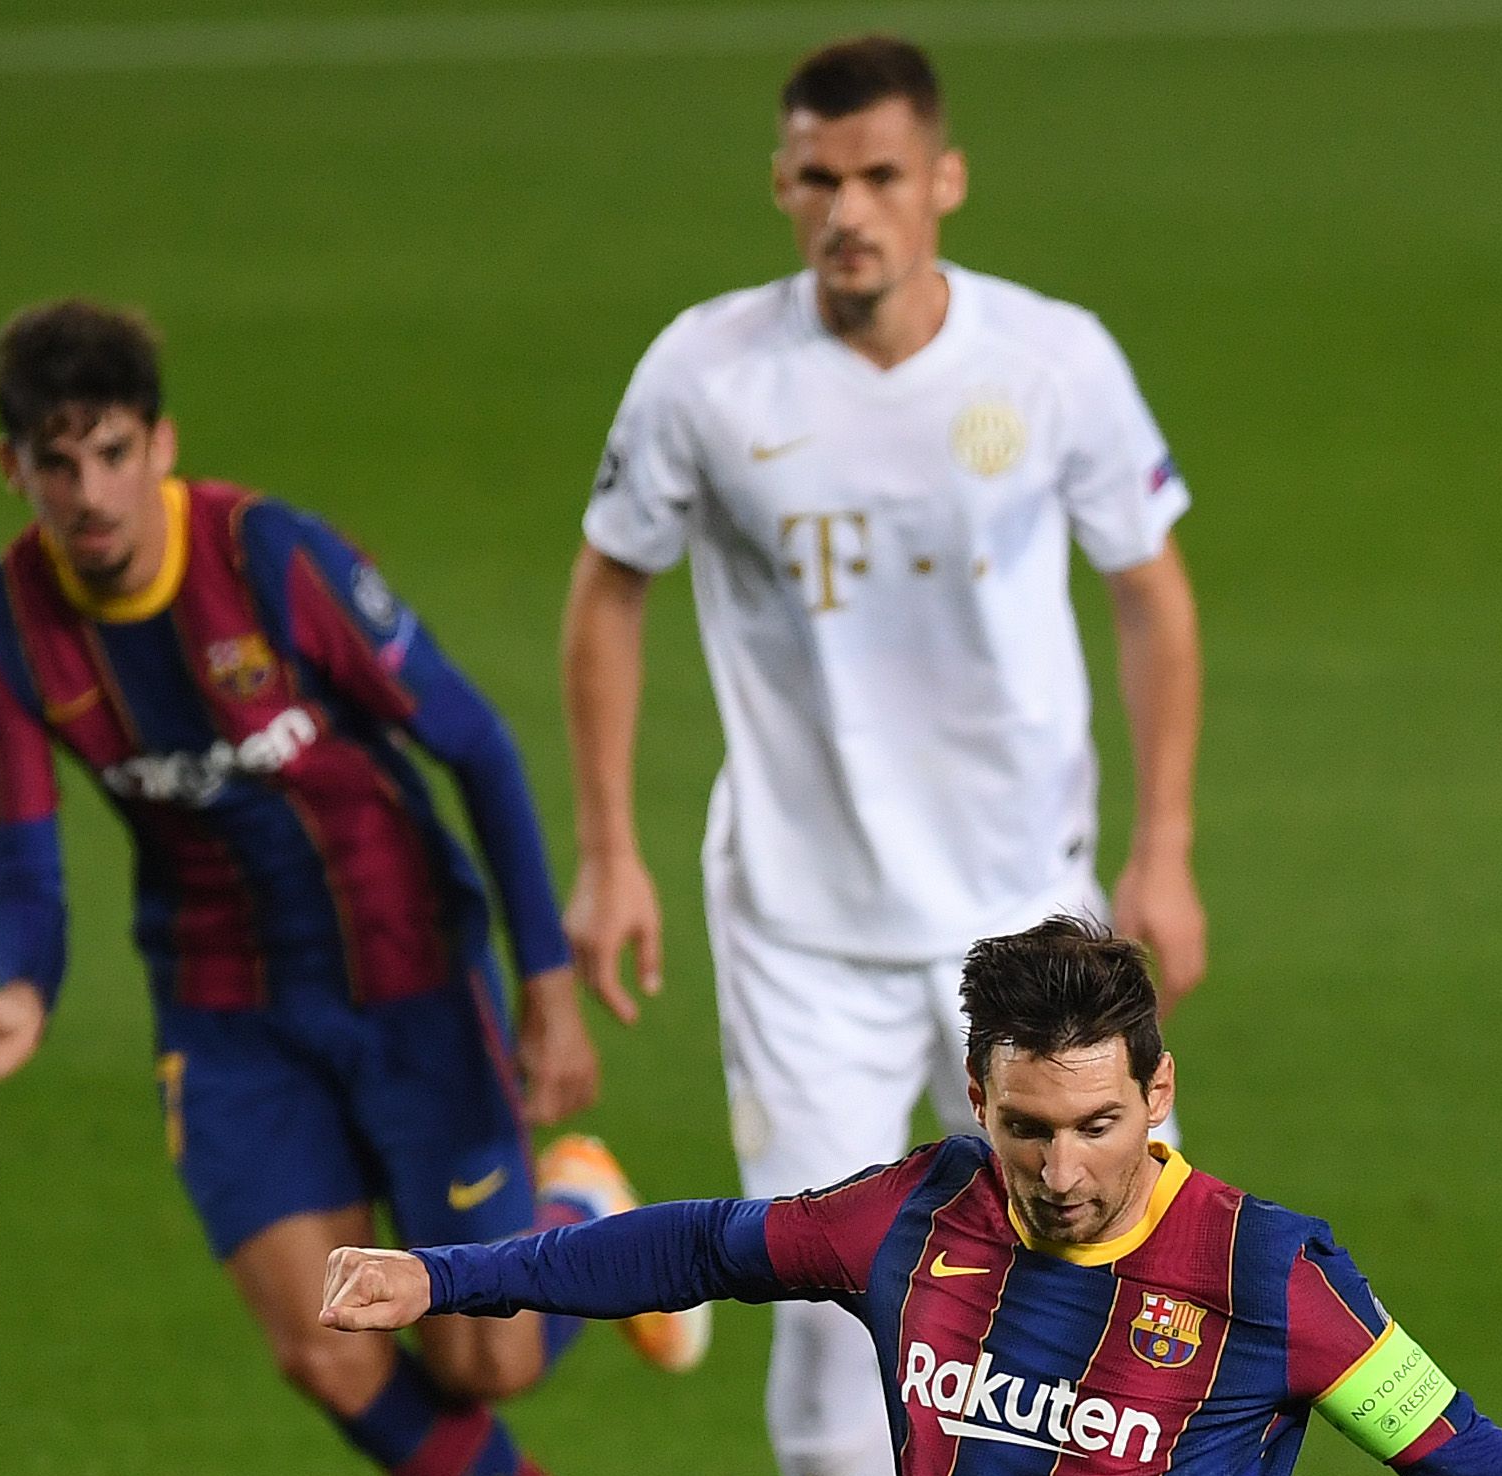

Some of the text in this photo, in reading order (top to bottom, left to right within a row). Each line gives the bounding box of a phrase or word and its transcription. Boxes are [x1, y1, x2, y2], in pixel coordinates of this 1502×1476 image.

[901, 1340, 1162, 1463] Rakuten
[1350, 1398, 1376, 1421] NO
[1374, 1379, 1395, 1399] TO
